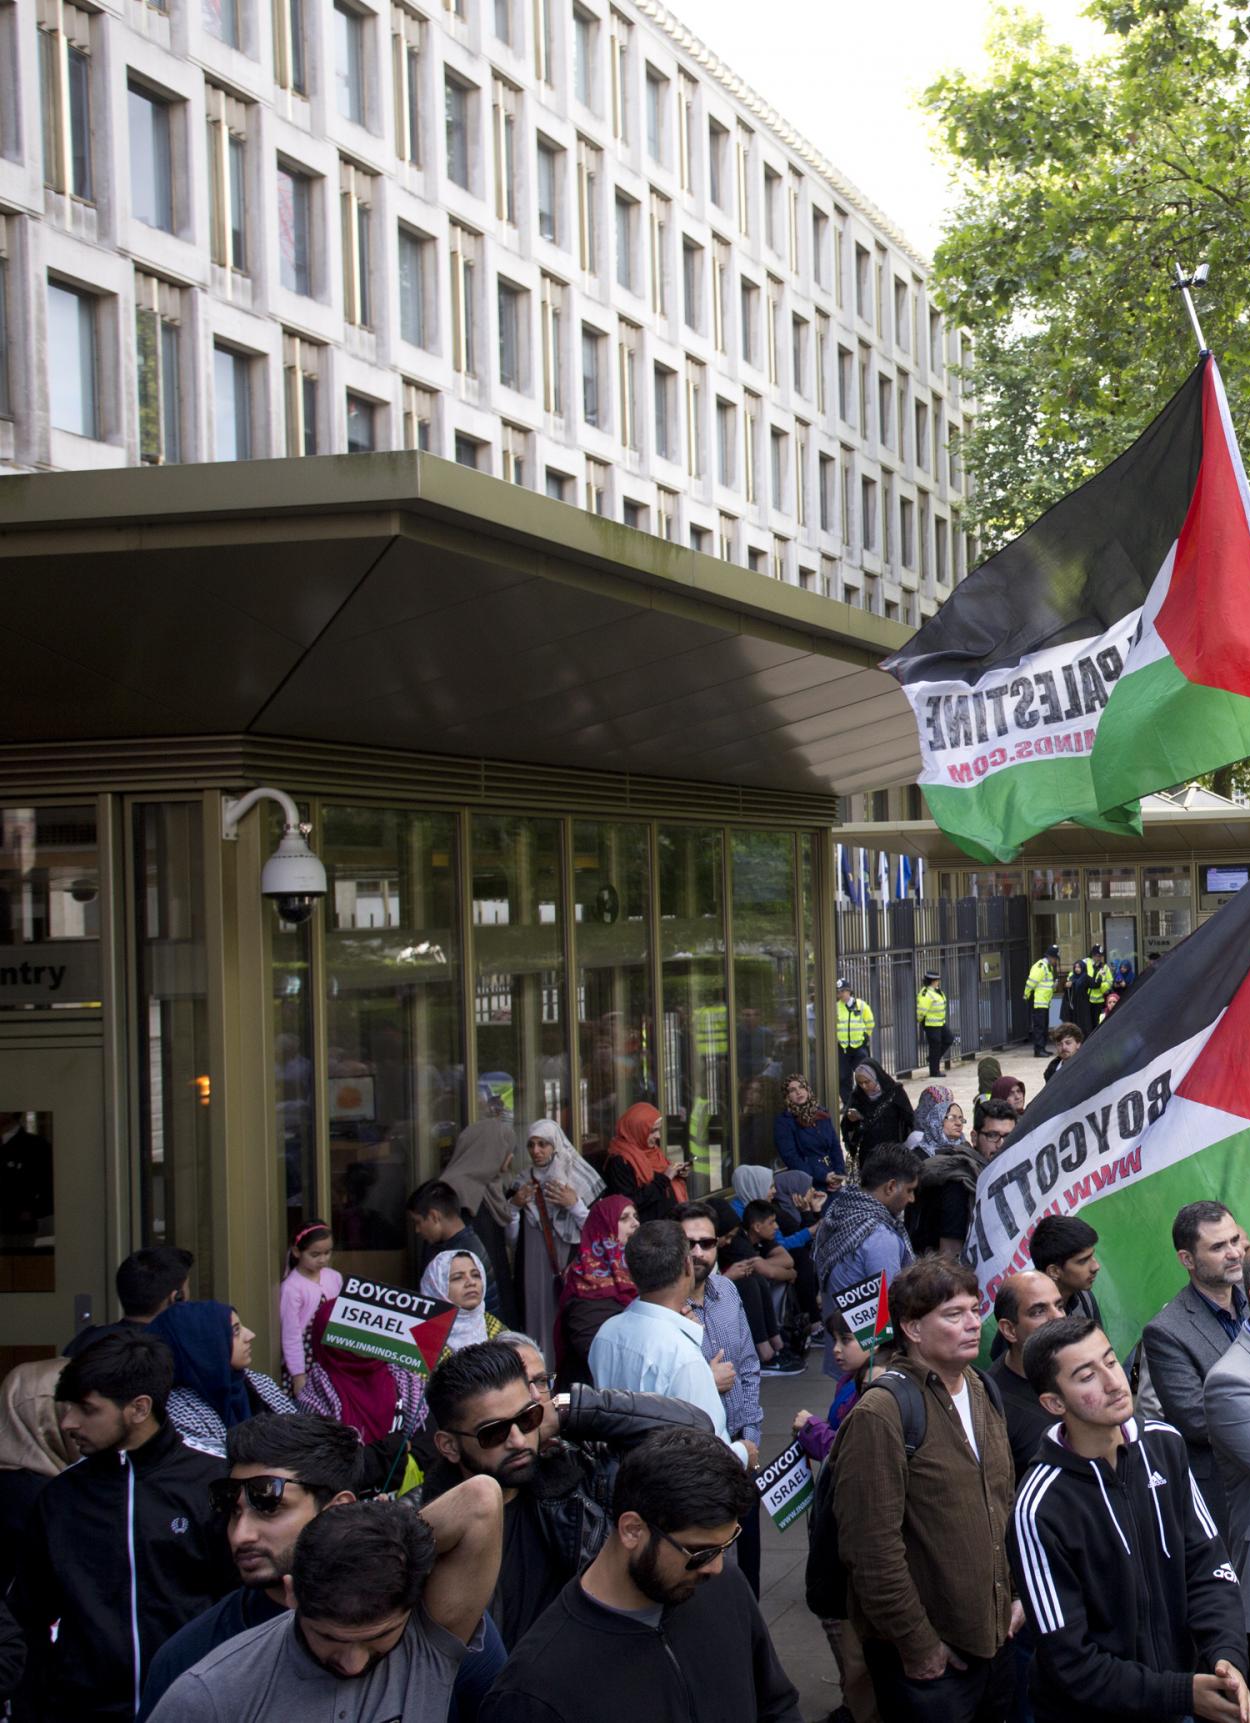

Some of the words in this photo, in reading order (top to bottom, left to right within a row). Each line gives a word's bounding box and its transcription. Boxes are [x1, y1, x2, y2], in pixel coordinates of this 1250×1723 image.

[346, 1278, 436, 1315] BOYCOTT
[836, 1276, 881, 1308] BOYCOT
[341, 1306, 405, 1335] ISRAEL
[851, 1304, 878, 1327] ISRA
[326, 1333, 422, 1368] WWW.INMINDS.COM
[755, 1441, 801, 1491] BOYCOT
[769, 1469, 808, 1507] ISRAEL
